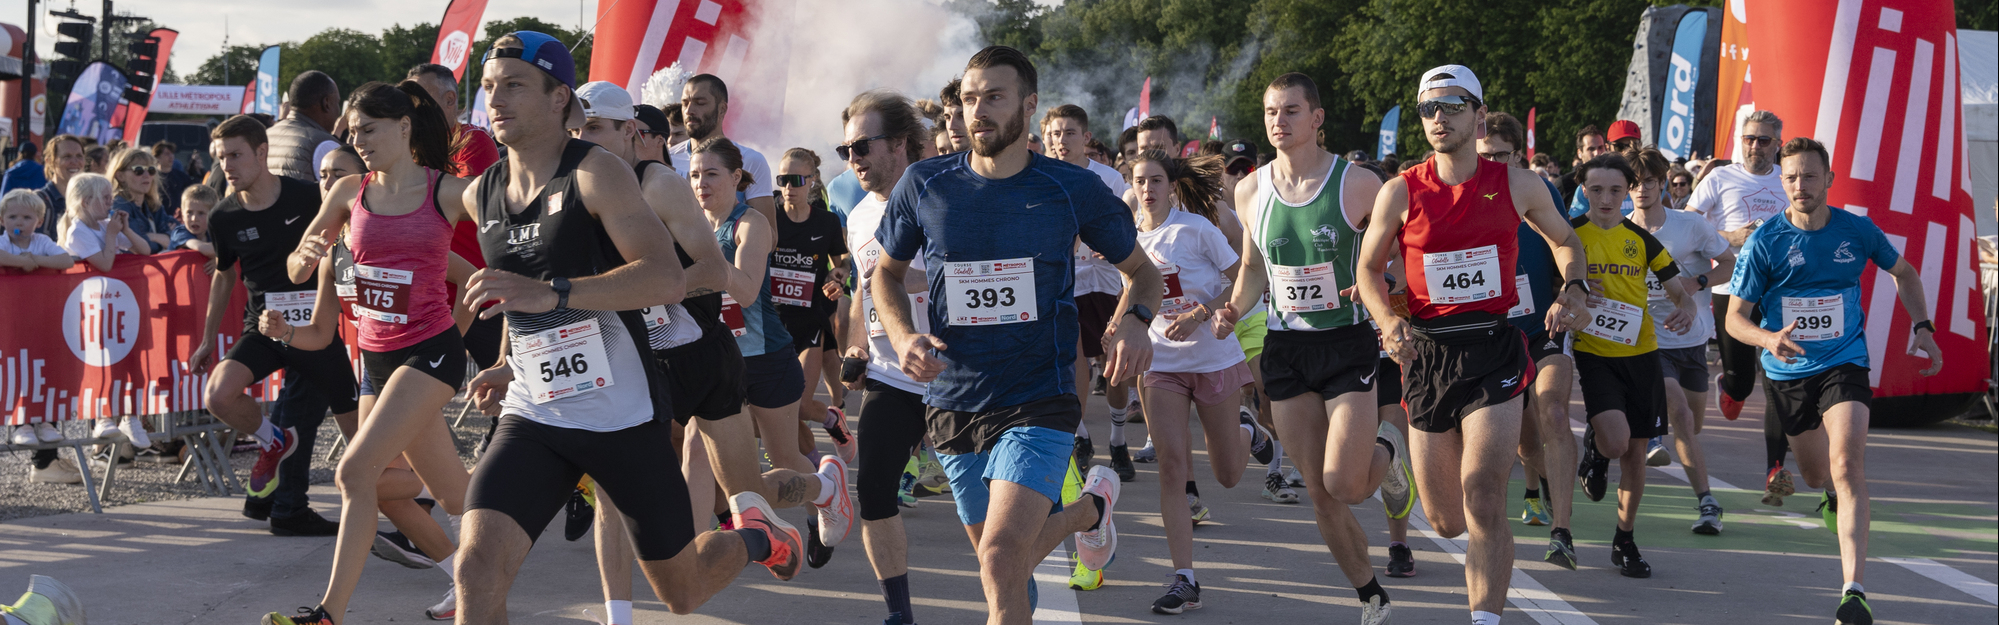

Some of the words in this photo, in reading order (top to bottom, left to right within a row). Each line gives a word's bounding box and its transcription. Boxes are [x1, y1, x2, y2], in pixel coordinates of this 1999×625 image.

[158, 92, 179, 100] LILLE
[1625, 245, 1637, 254] BVB
[1443, 270, 1485, 290] 464
[777, 283, 803, 297] 105
[1286, 285, 1323, 300] 372
[364, 288, 394, 308] 175
[965, 287, 1016, 309] 393
[283, 308, 312, 322] 438
[1796, 315, 1832, 330] 399
[1596, 314, 1628, 332] 627
[542, 346, 563, 355] HOMMES
[564, 340, 588, 350] CHRONO
[540, 353, 588, 383] 546
